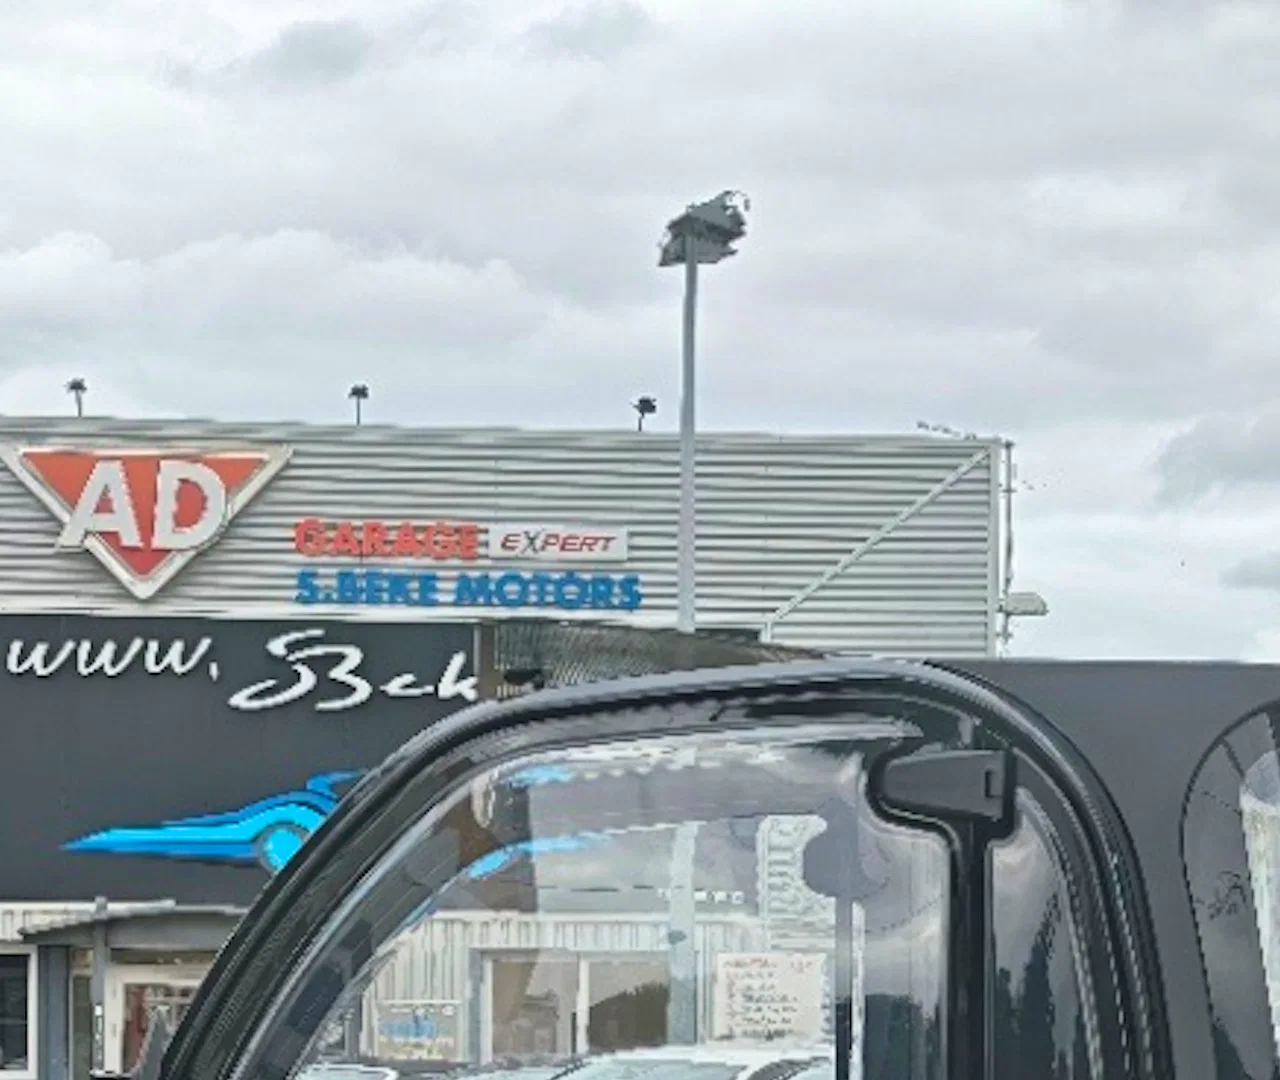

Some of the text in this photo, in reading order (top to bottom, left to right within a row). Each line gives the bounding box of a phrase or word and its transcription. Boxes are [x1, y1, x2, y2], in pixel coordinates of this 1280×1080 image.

[54, 459, 231, 552] AD
[294, 519, 480, 562] GARAGE
[296, 570, 642, 610] S.BEKE MOTORS
